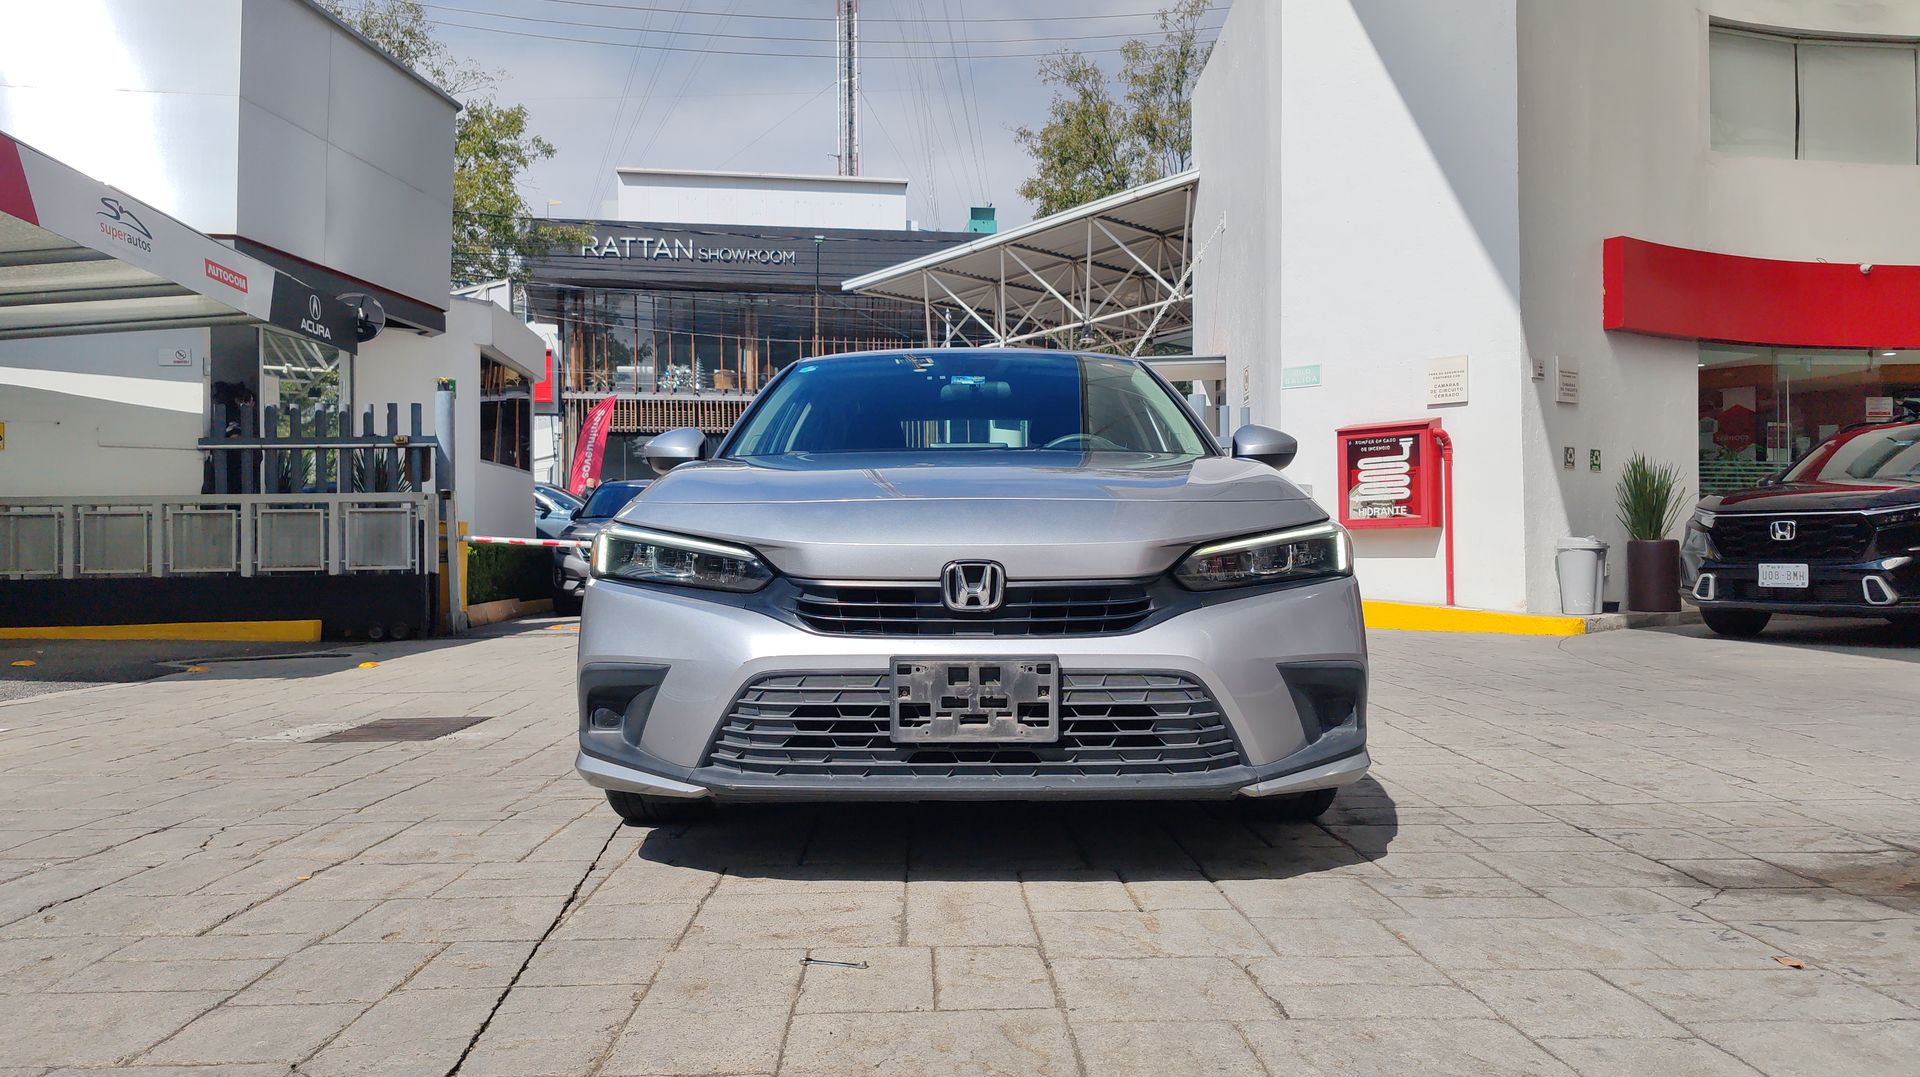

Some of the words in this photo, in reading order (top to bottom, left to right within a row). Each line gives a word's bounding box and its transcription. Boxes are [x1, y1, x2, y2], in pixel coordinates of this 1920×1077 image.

[100, 222, 152, 252] superautos
[581, 236, 694, 259] RATTAN
[698, 247, 796, 264] SHOWROOM
[207, 264, 247, 290] AUTOCOM
[300, 317, 332, 340] ACURA
[581, 408, 606, 479] Seminuevos
[1358, 505, 1408, 517] HIDRANTE
